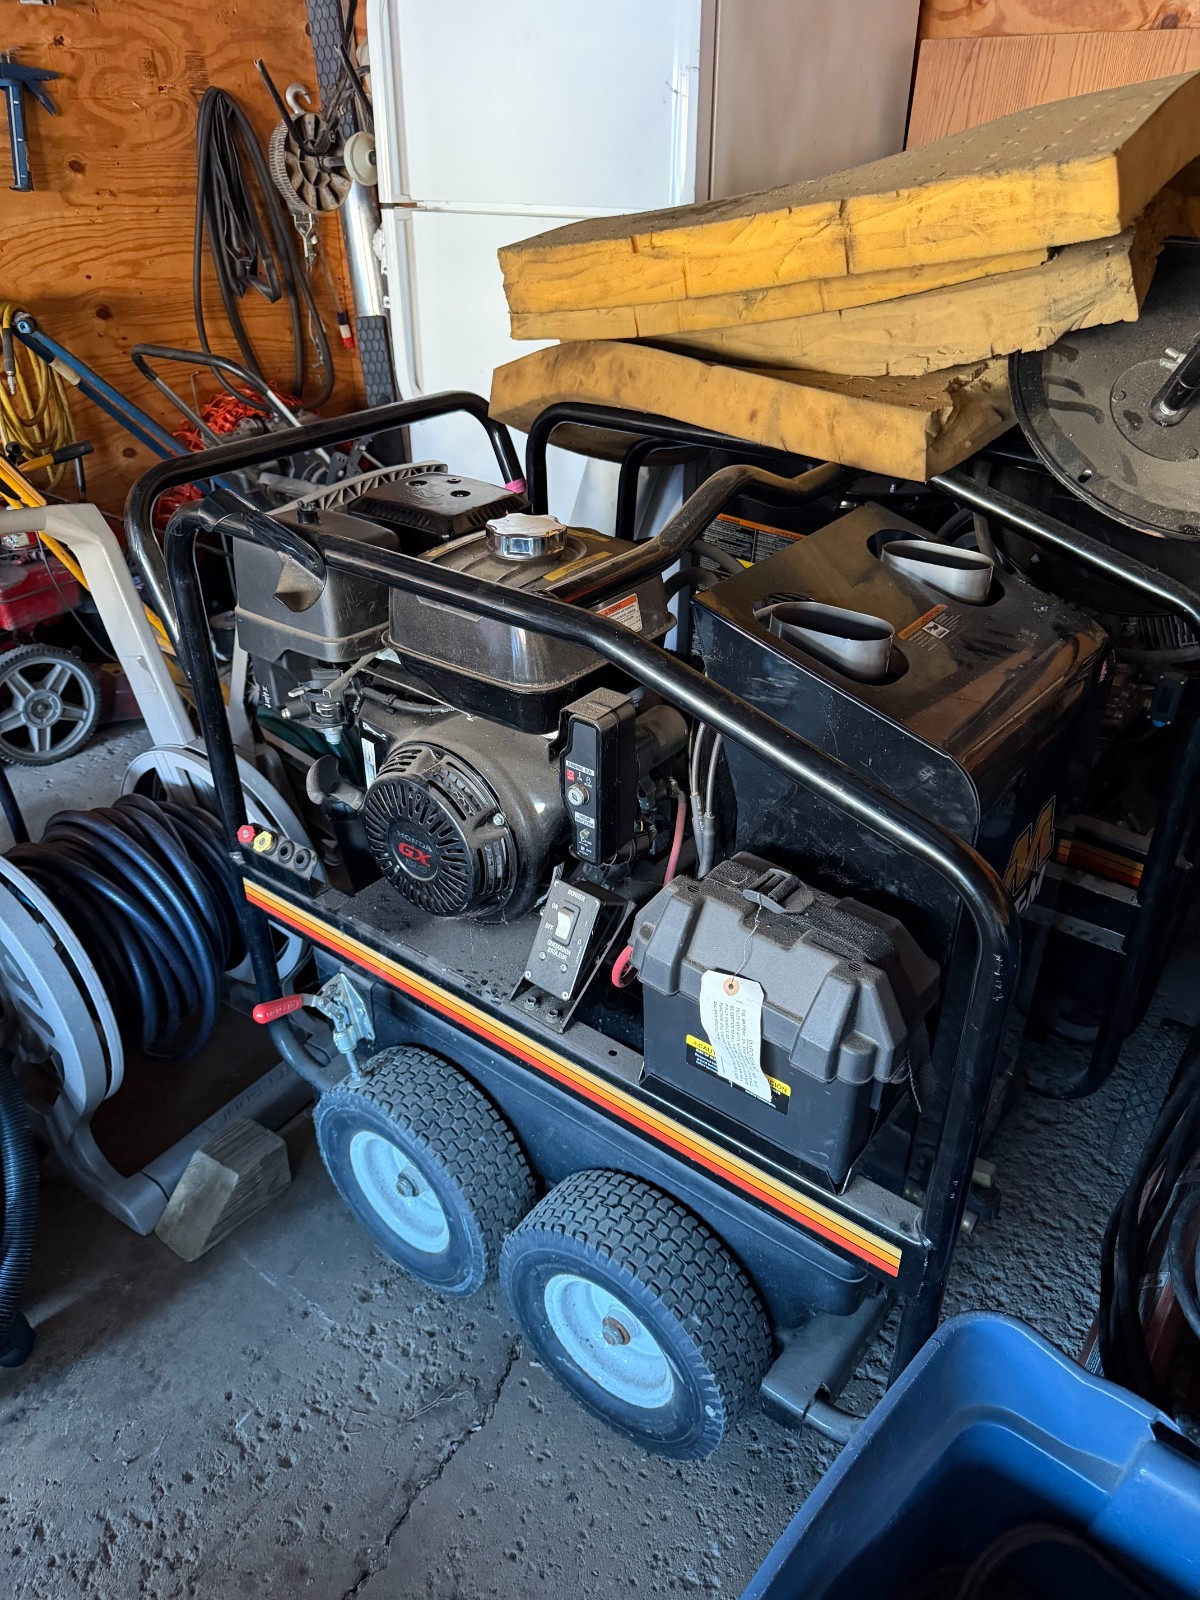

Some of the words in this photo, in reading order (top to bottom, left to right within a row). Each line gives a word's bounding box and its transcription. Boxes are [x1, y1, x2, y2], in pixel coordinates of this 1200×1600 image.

[396, 830, 433, 852] HONDA
[398, 842, 432, 867] GX
[567, 888, 586, 902] BURNER
[551, 902, 559, 911] ON
[544, 922, 554, 931] OFF
[547, 940, 572, 956] QUEMADOR
